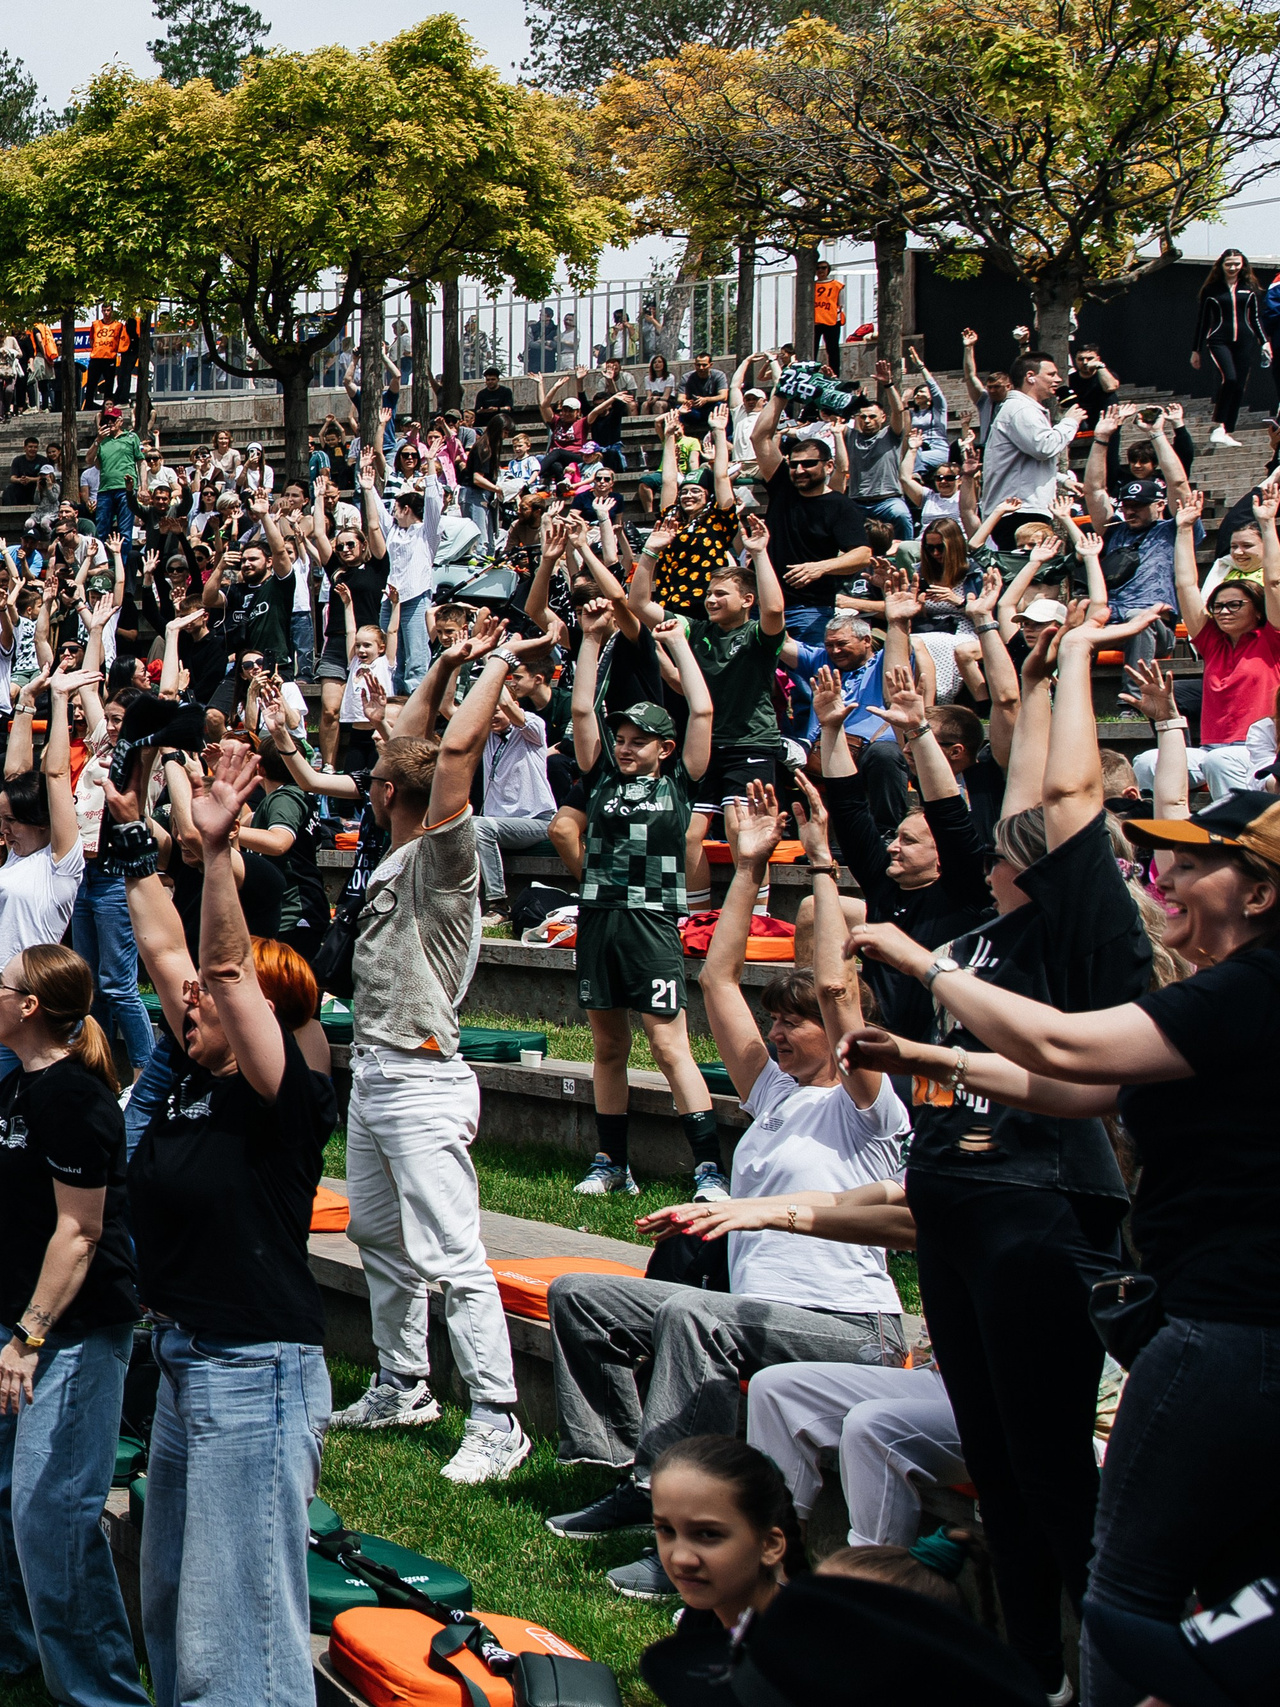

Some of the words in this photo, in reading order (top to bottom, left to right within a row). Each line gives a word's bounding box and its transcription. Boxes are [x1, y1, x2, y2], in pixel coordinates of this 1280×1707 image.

[817, 286, 833, 297] 91
[97, 328, 115, 338] 682
[651, 978, 677, 1009] 21
[564, 1081, 574, 1092] 36
